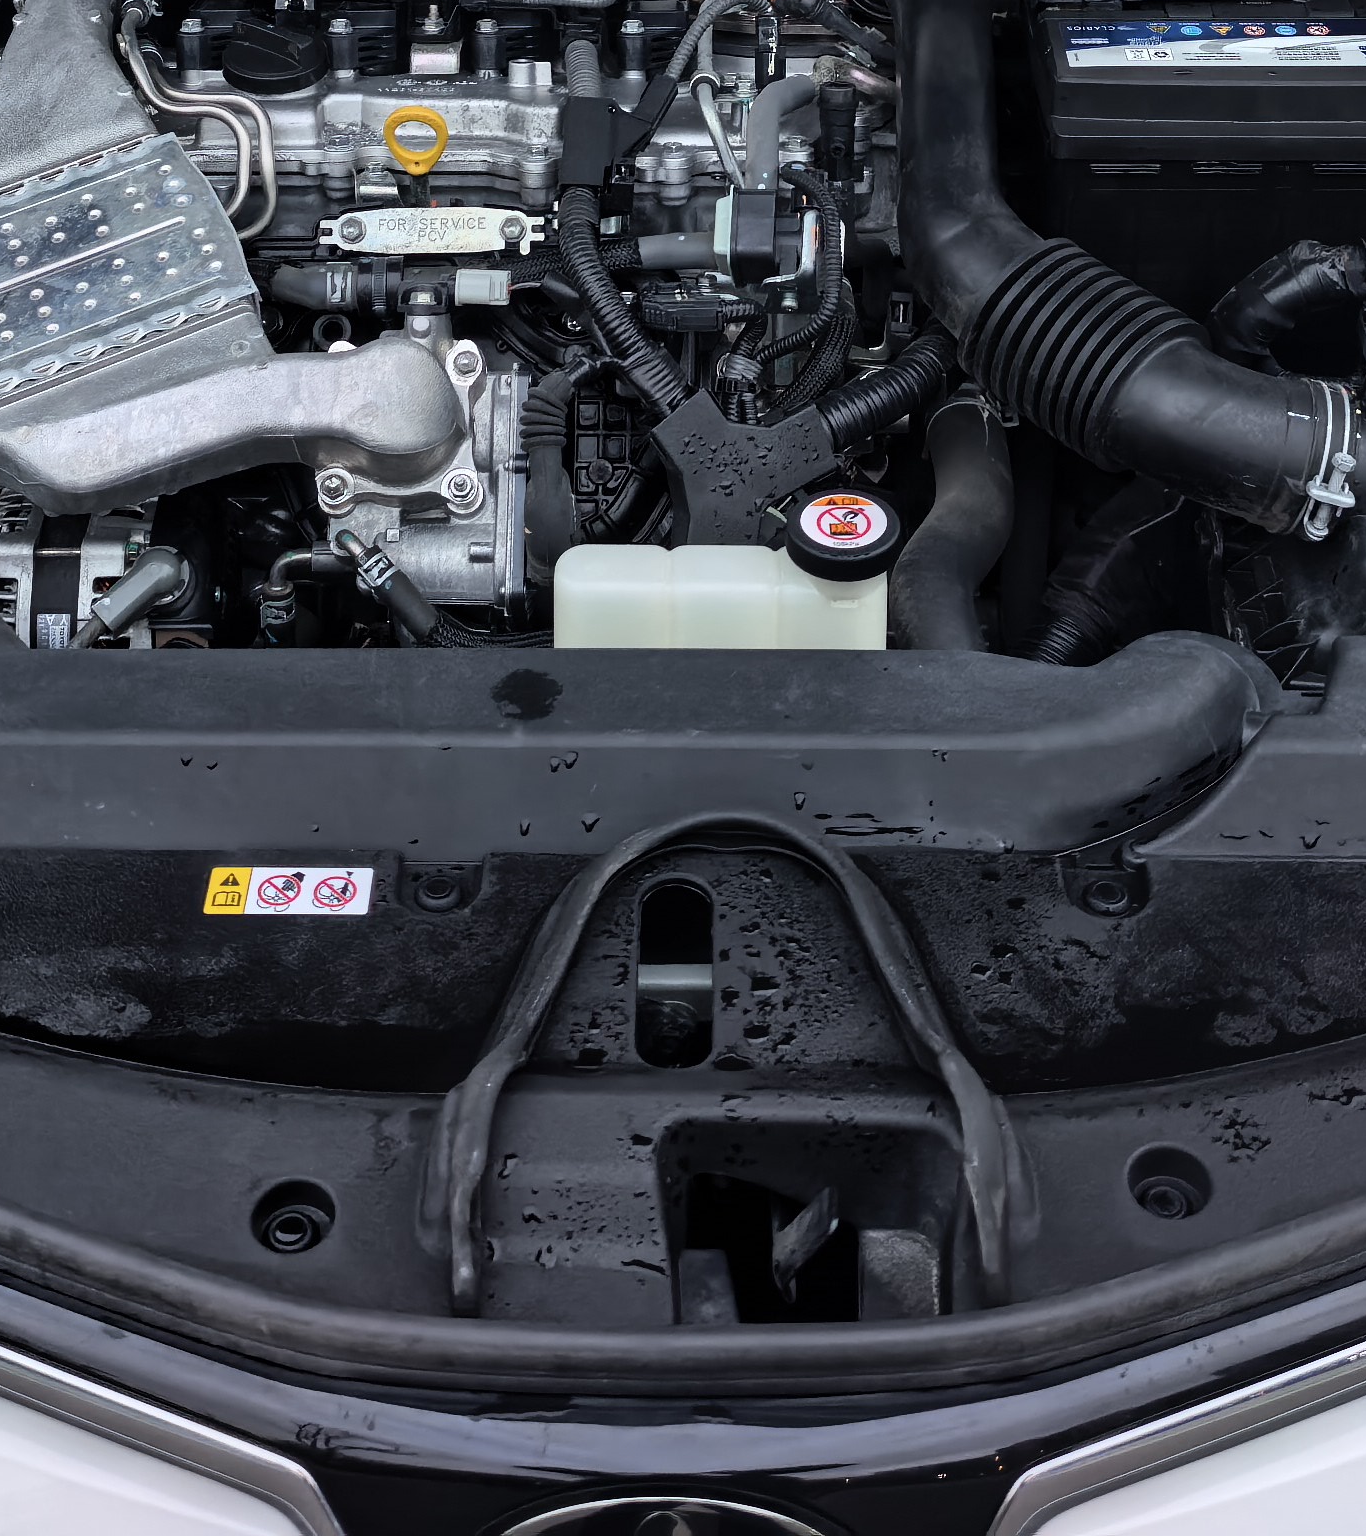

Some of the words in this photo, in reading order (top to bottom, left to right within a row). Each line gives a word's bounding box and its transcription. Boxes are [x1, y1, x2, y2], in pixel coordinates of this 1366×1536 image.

[378, 219, 407, 231] FOR
[418, 217, 487, 231] SERVICE
[417, 229, 447, 242] PCV
